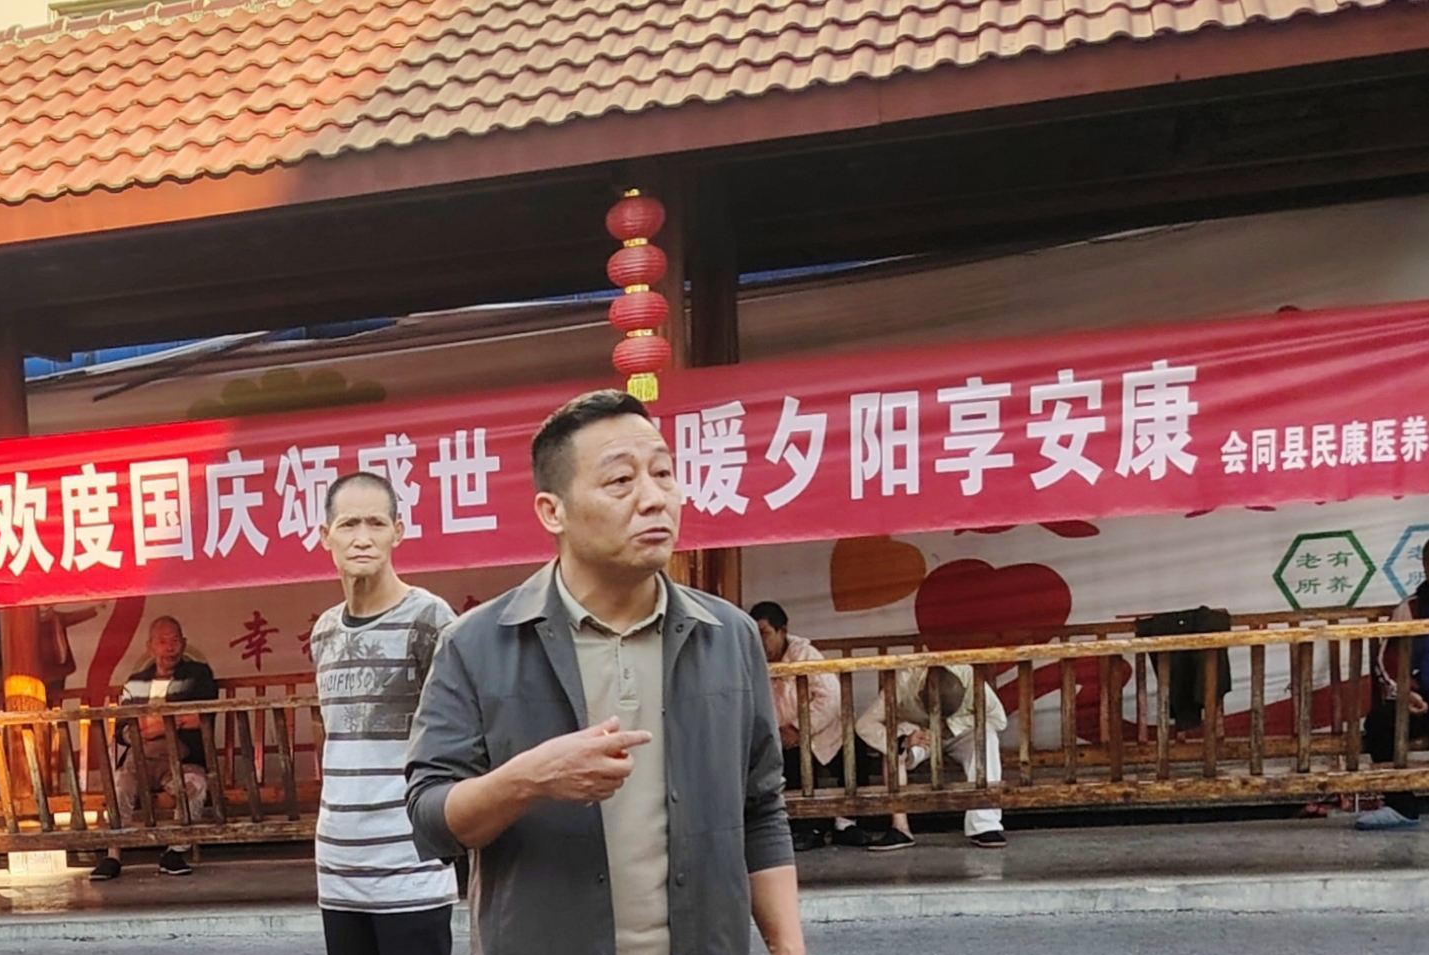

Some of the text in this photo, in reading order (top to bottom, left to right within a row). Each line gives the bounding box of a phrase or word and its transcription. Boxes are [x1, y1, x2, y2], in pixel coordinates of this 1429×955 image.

[651, 359, 1199, 515] 暖夕阳享安康
[1221, 416, 1429, 474] 会同县民康医养
